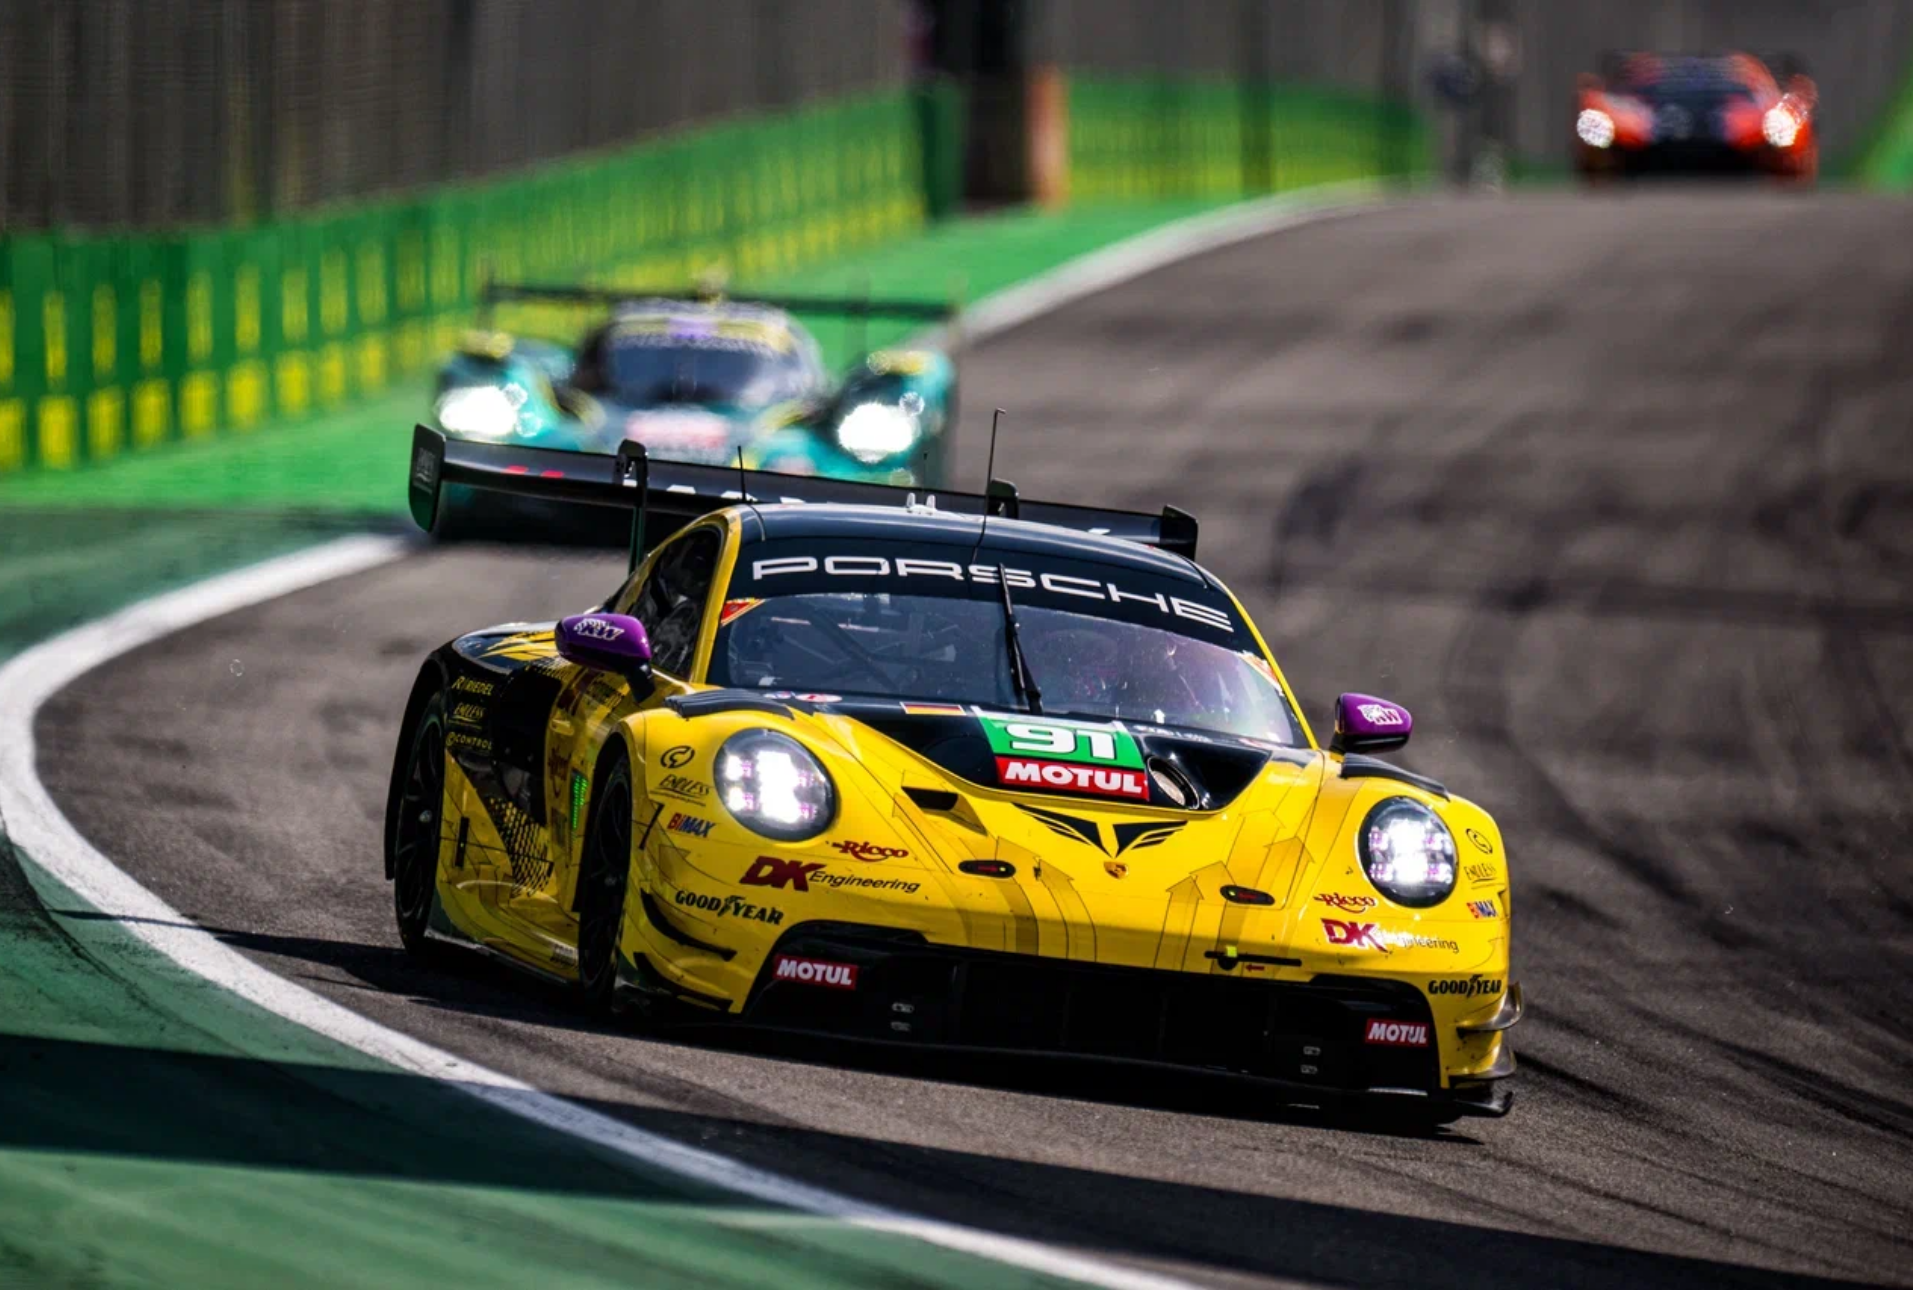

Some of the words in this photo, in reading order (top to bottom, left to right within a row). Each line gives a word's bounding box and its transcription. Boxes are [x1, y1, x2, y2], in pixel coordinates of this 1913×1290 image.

[753, 556, 1234, 632] PORSCHE
[1005, 723, 1117, 760] 91
[1005, 762, 1142, 794] MOTUL
[739, 856, 825, 892] DK
[809, 871, 921, 893] Engineering
[675, 890, 784, 925] GOODYEAR
[1320, 918, 1389, 953] DK
[776, 959, 852, 985] MOTUL
[1368, 1022, 1427, 1044] MOTUL
